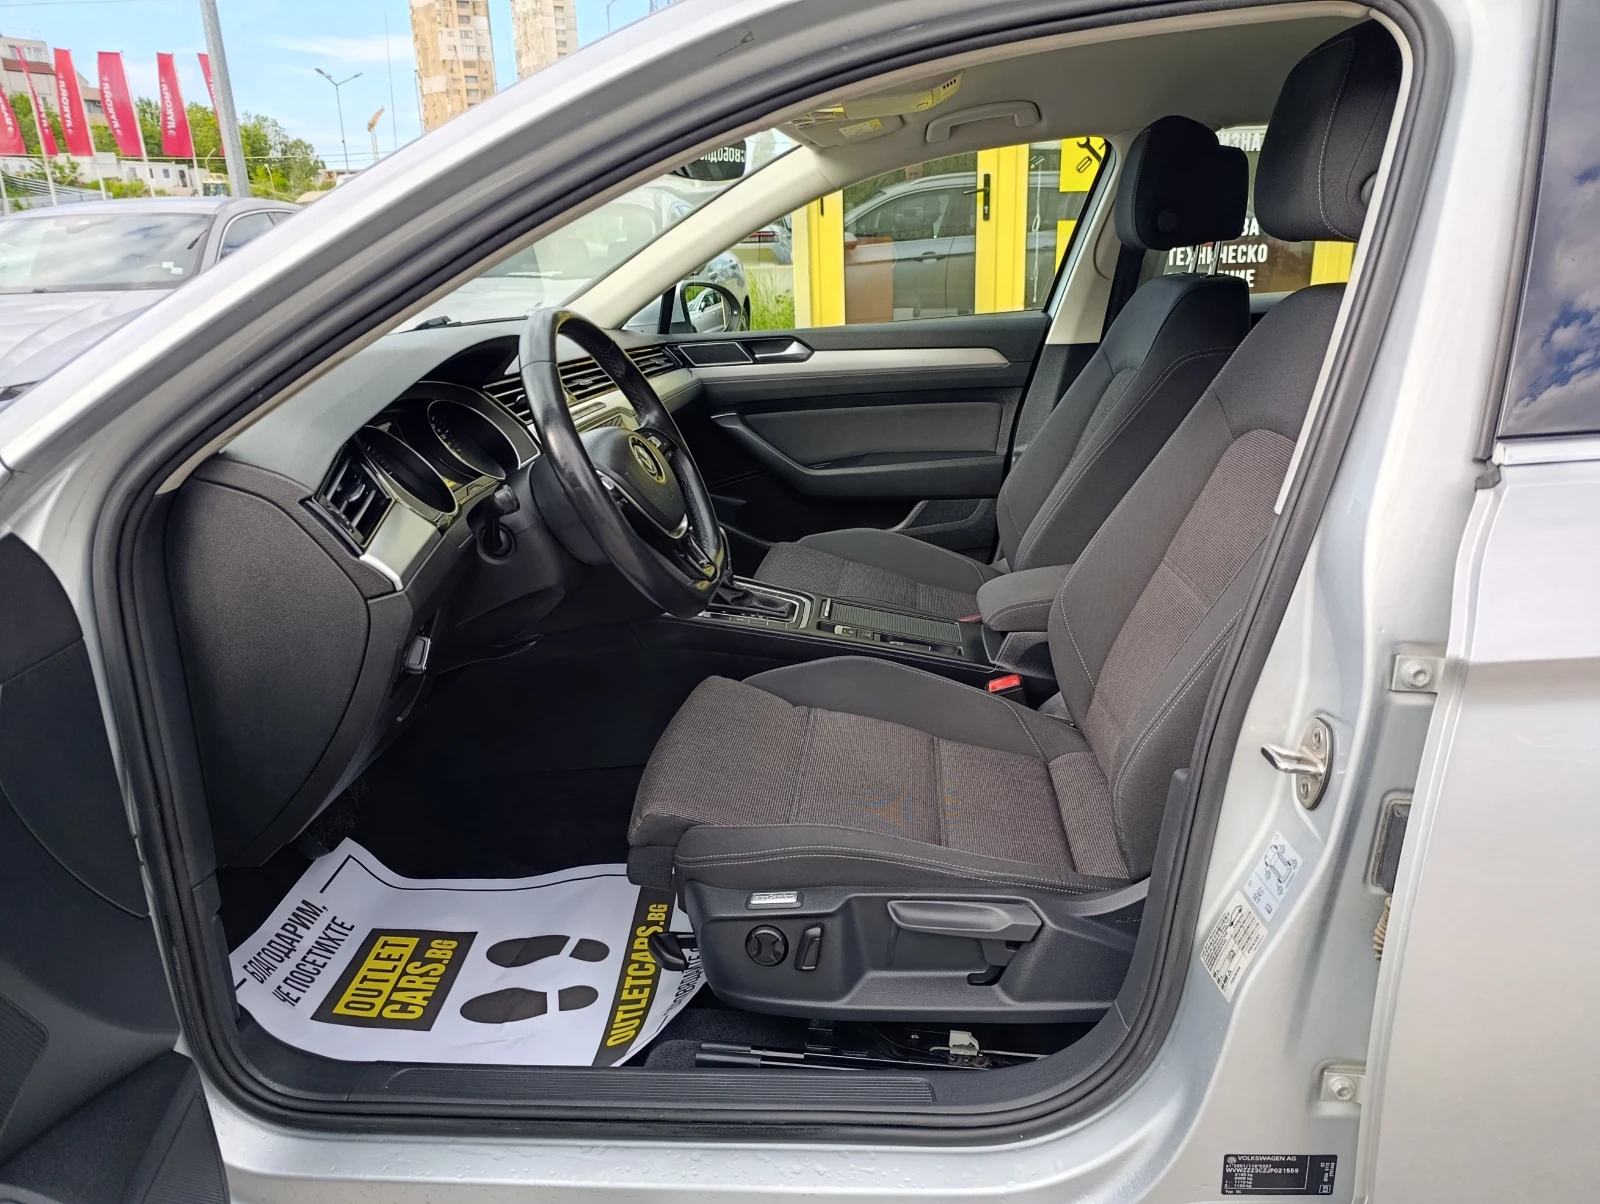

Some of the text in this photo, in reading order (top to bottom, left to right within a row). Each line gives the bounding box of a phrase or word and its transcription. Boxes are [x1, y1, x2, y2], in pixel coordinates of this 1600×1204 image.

[242, 899, 329, 984] БЛАГОДАРИМ,
[272, 915, 356, 1007] ЧЕ ПОСЕТИХТЕ
[343, 940, 410, 1012] OUTLET
[381, 939, 458, 1020] CARS.BG
